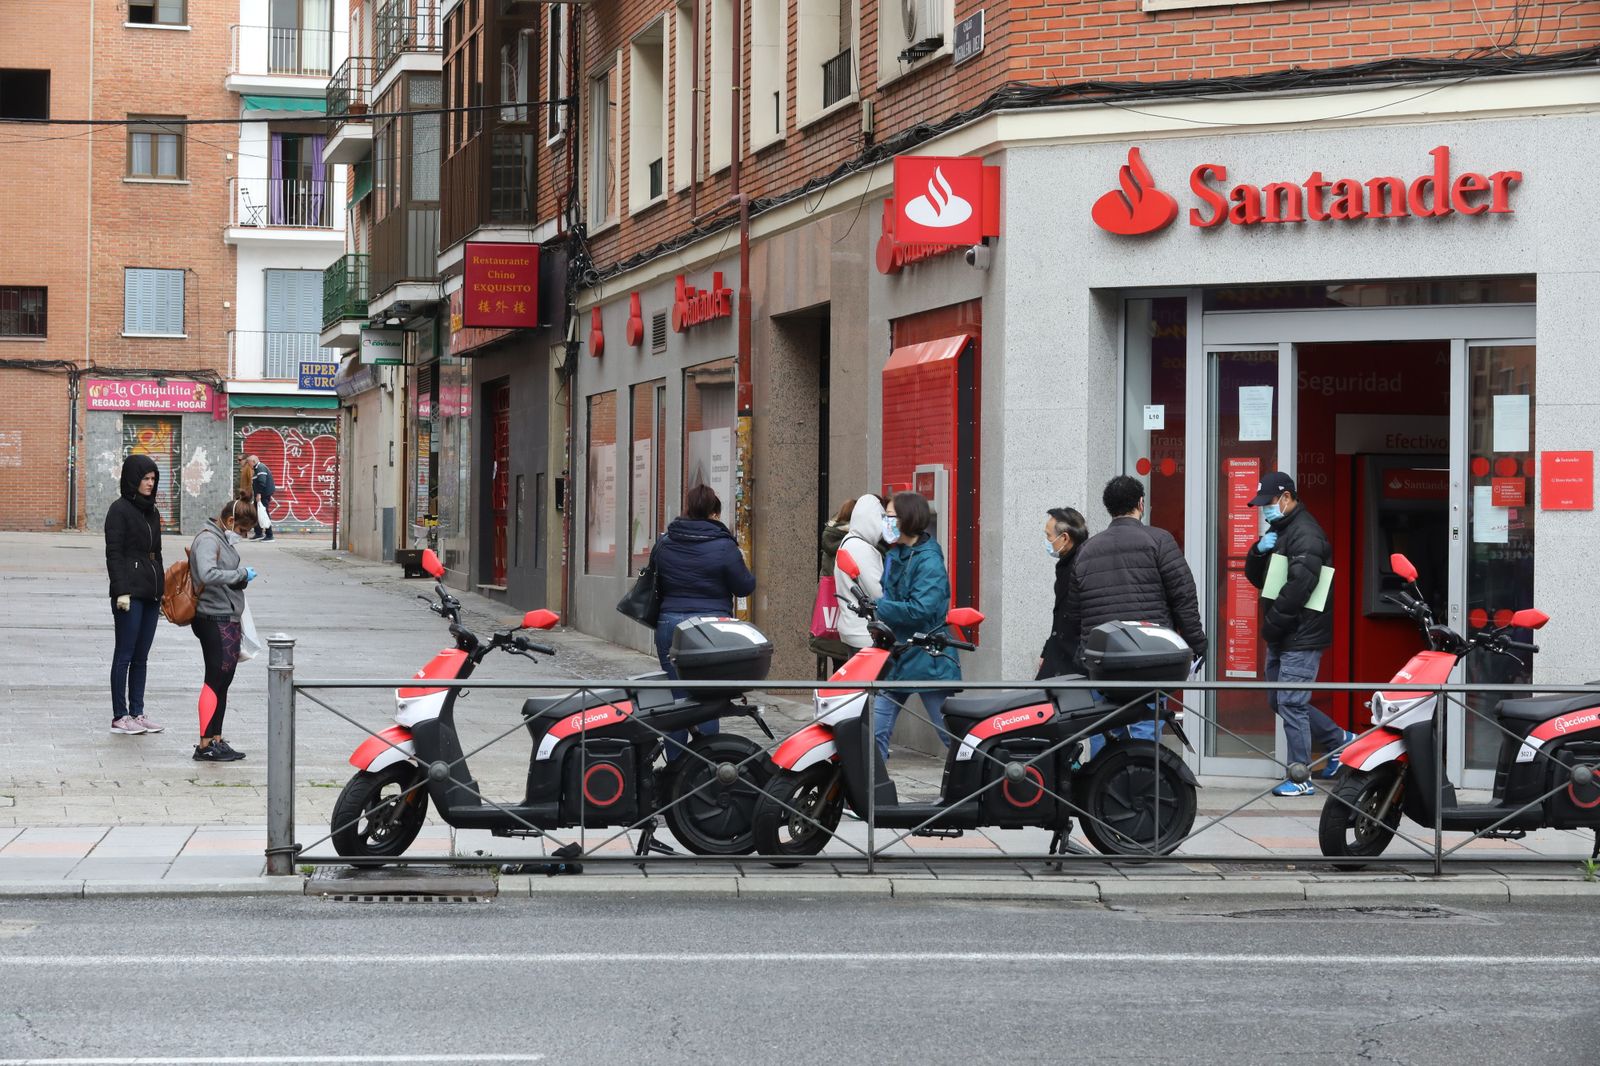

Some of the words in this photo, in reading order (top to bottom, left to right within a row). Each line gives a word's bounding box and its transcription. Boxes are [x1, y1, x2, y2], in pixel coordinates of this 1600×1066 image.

[1189, 145, 1523, 228] Santander
[472, 256, 529, 266] Restaurante
[487, 270, 516, 279] Chino
[473, 283, 531, 293] EXQUISITO
[301, 363, 336, 376] HIPER
[1298, 370, 1402, 396] Seguridad
[109, 383, 128, 398] La
[130, 383, 191, 398] Chiquitita
[92, 399, 130, 408] REGALOS
[137, 400, 171, 409] MENAJE
[177, 401, 206, 409] HOGAR
[1385, 433, 1447, 449] Efectivo
[1403, 478, 1450, 490] Santande
[1001, 713, 1030, 727] acciona
[1563, 713, 1597, 728] acciona
